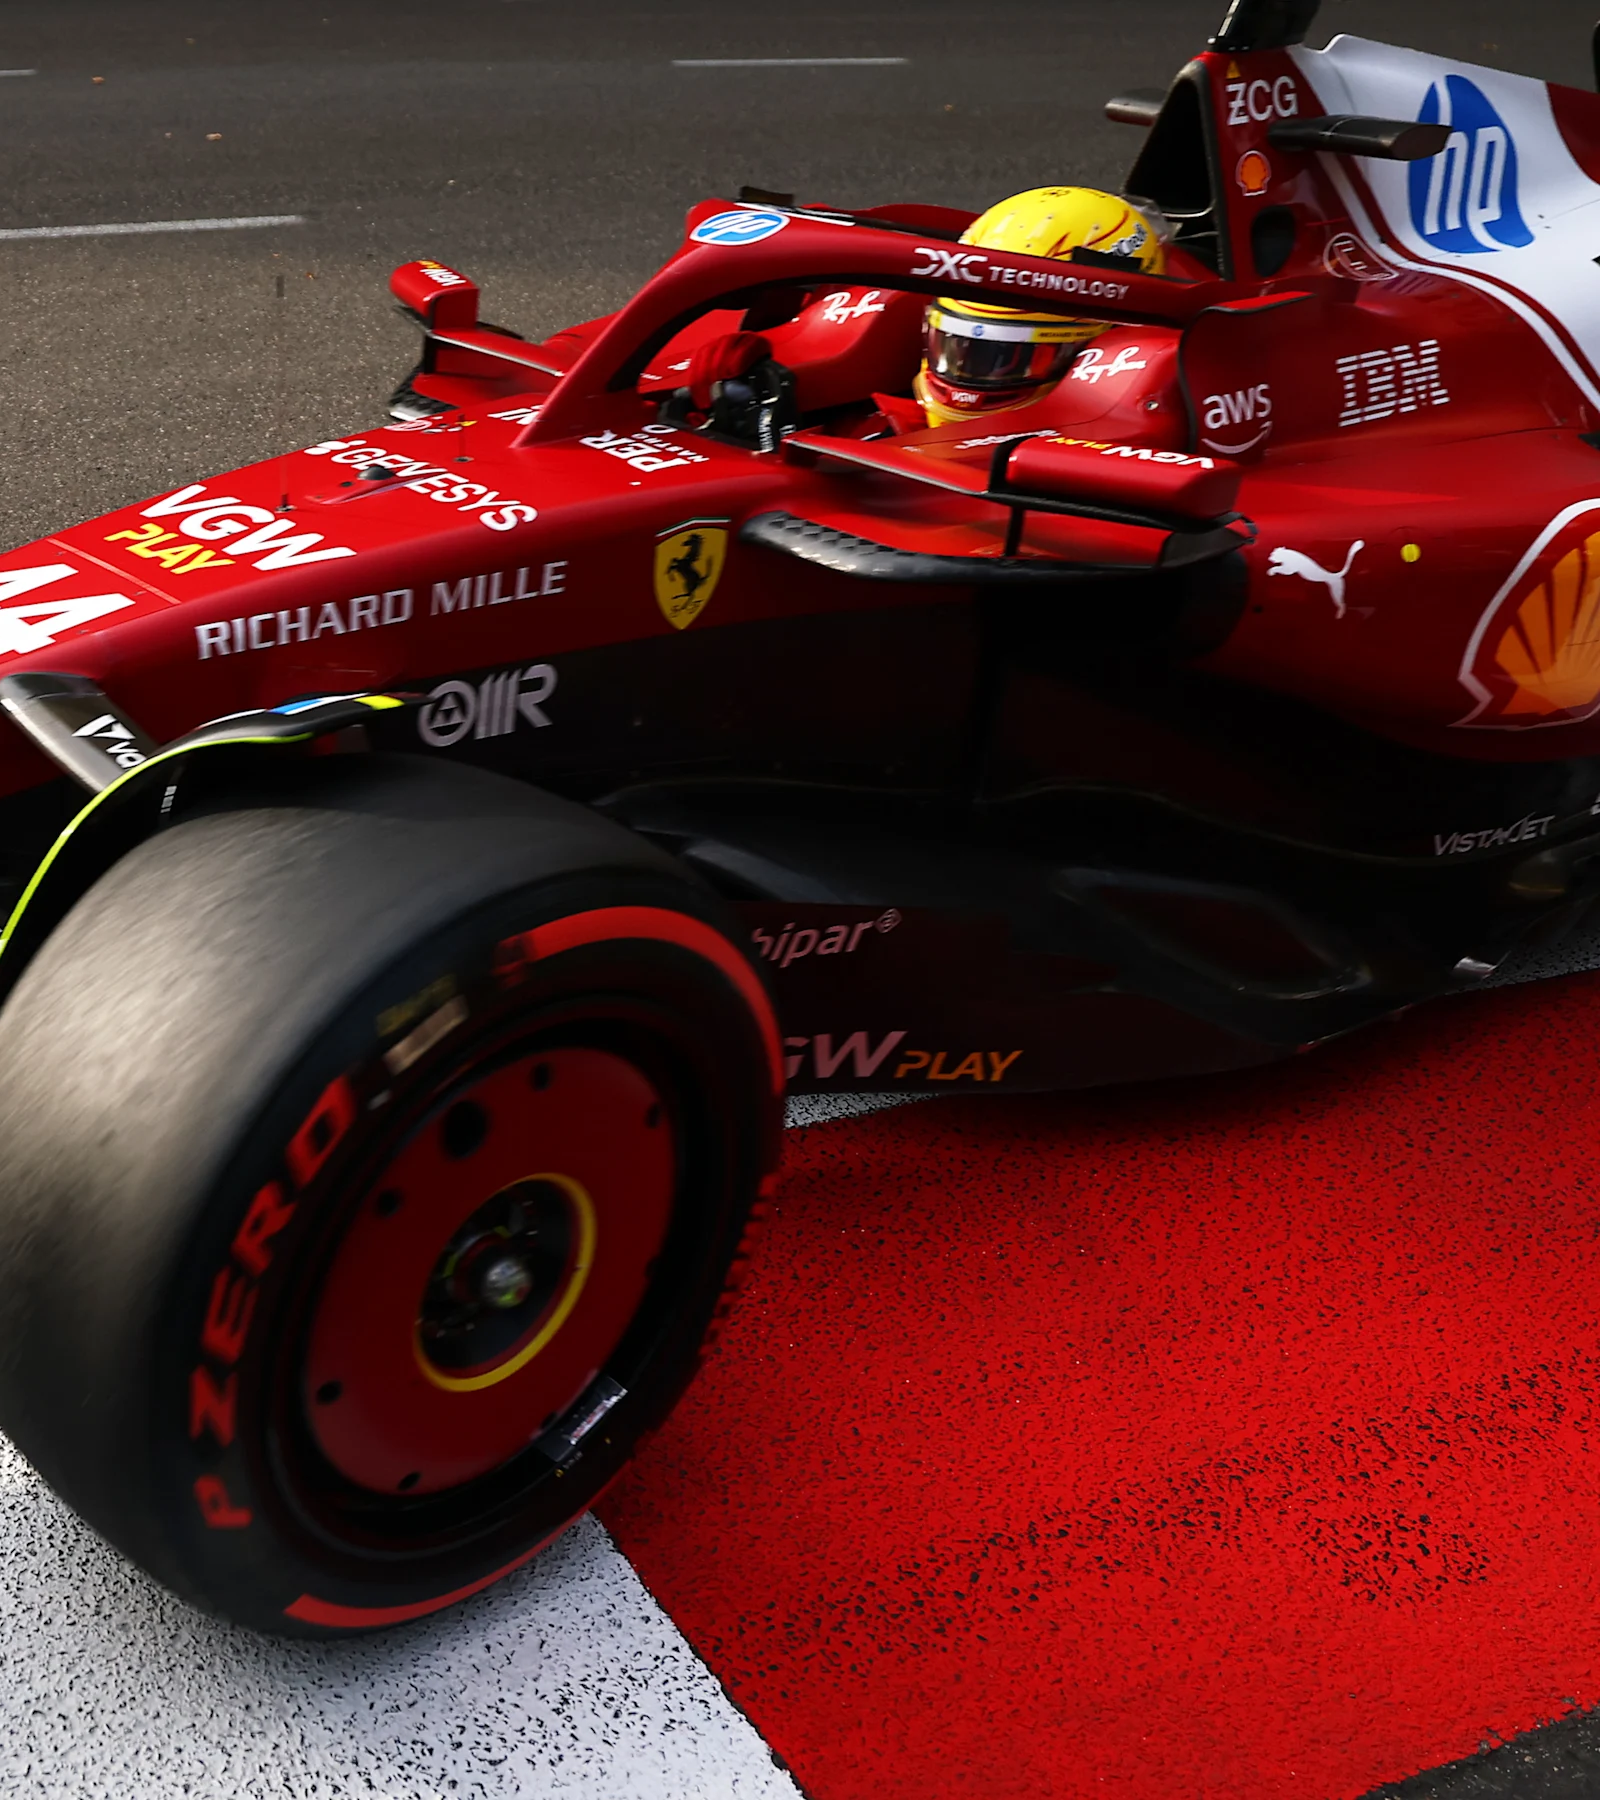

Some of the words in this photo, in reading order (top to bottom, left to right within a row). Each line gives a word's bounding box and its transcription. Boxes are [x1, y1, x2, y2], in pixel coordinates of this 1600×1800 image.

[910, 247, 988, 283] DXC
[988, 265, 1130, 300] TECHNOLOGY
[1203, 384, 1272, 430] aws
[1336, 340, 1450, 427] IBM
[631, 433, 709, 463] NASTRO
[1100, 446, 1214, 469] VGW
[331, 447, 538, 531] GENESYS
[104, 523, 234, 575] PLAY
[139, 484, 357, 570] VGW
[195, 601, 413, 660] RICHARD
[429, 560, 568, 617] MILLE
[894, 1050, 1023, 1082] PLAY
[191, 1073, 355, 1445] ZERO
[193, 1476, 251, 1528] P
